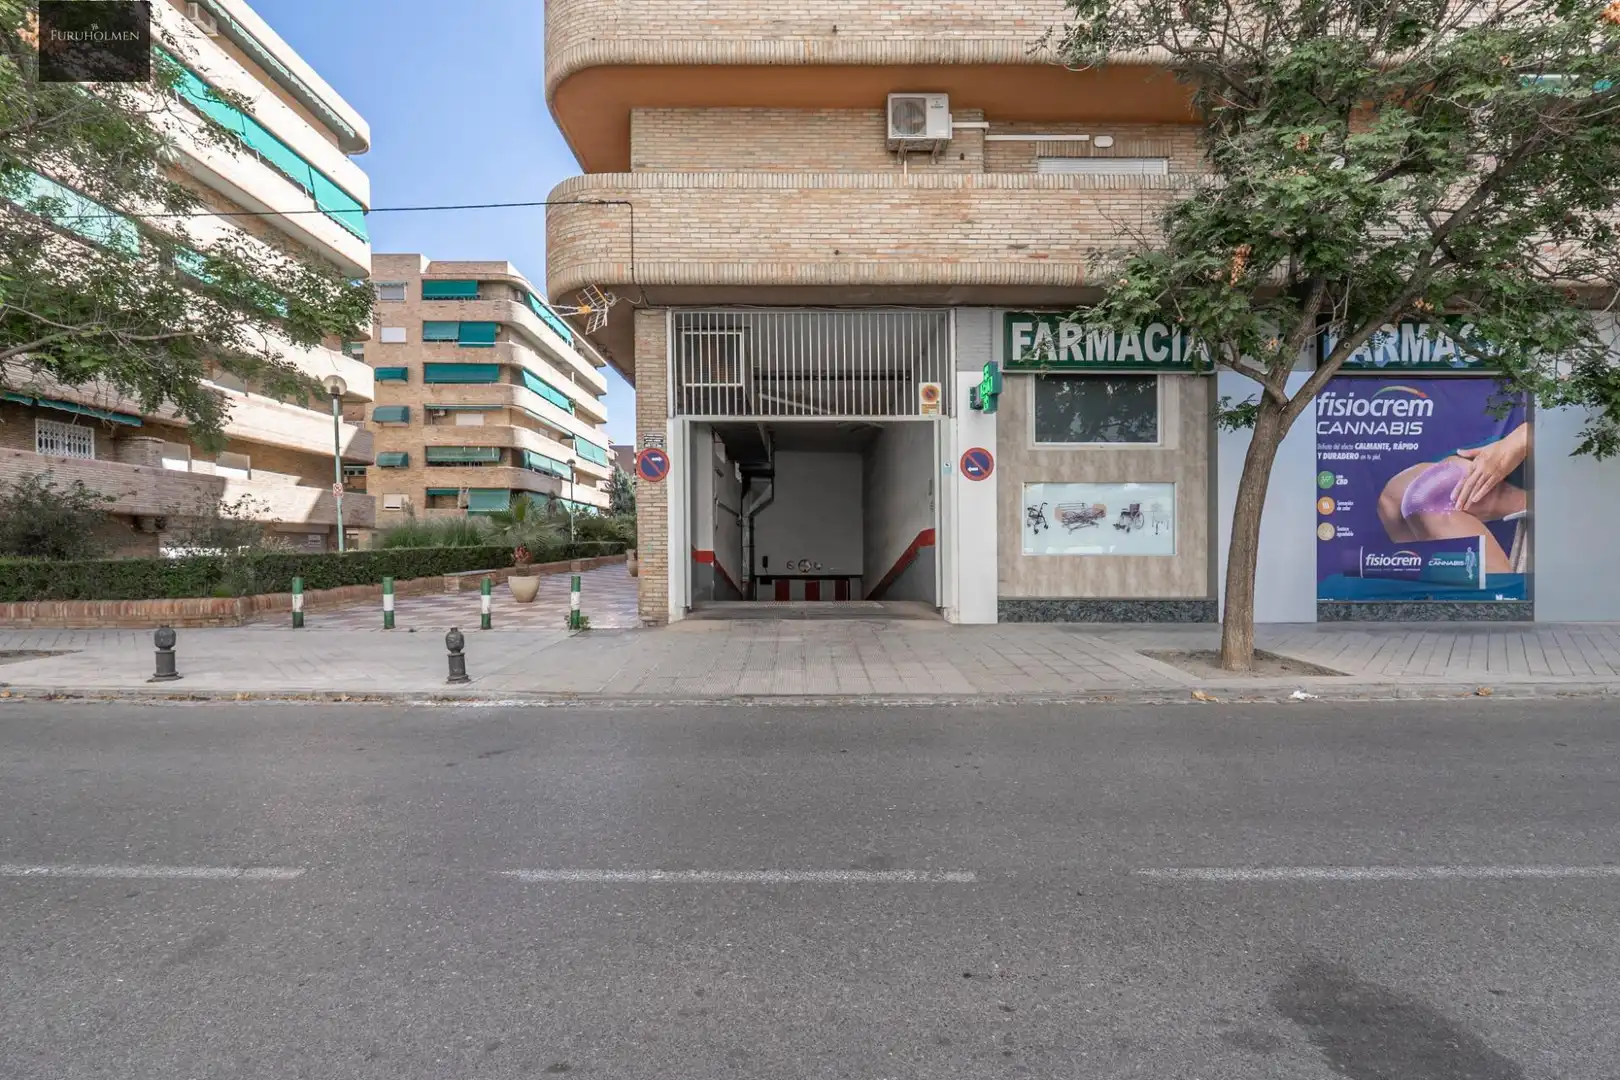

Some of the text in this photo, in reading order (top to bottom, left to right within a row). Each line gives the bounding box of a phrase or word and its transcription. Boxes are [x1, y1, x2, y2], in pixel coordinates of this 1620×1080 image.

[1317, 392, 1434, 417] fisiocrem
[1316, 421, 1423, 435] CANNABIS
[1393, 440, 1419, 450] RÁPIDO
[1323, 452, 1360, 460] DURADERO
[1365, 554, 1422, 567] fisiocrem
